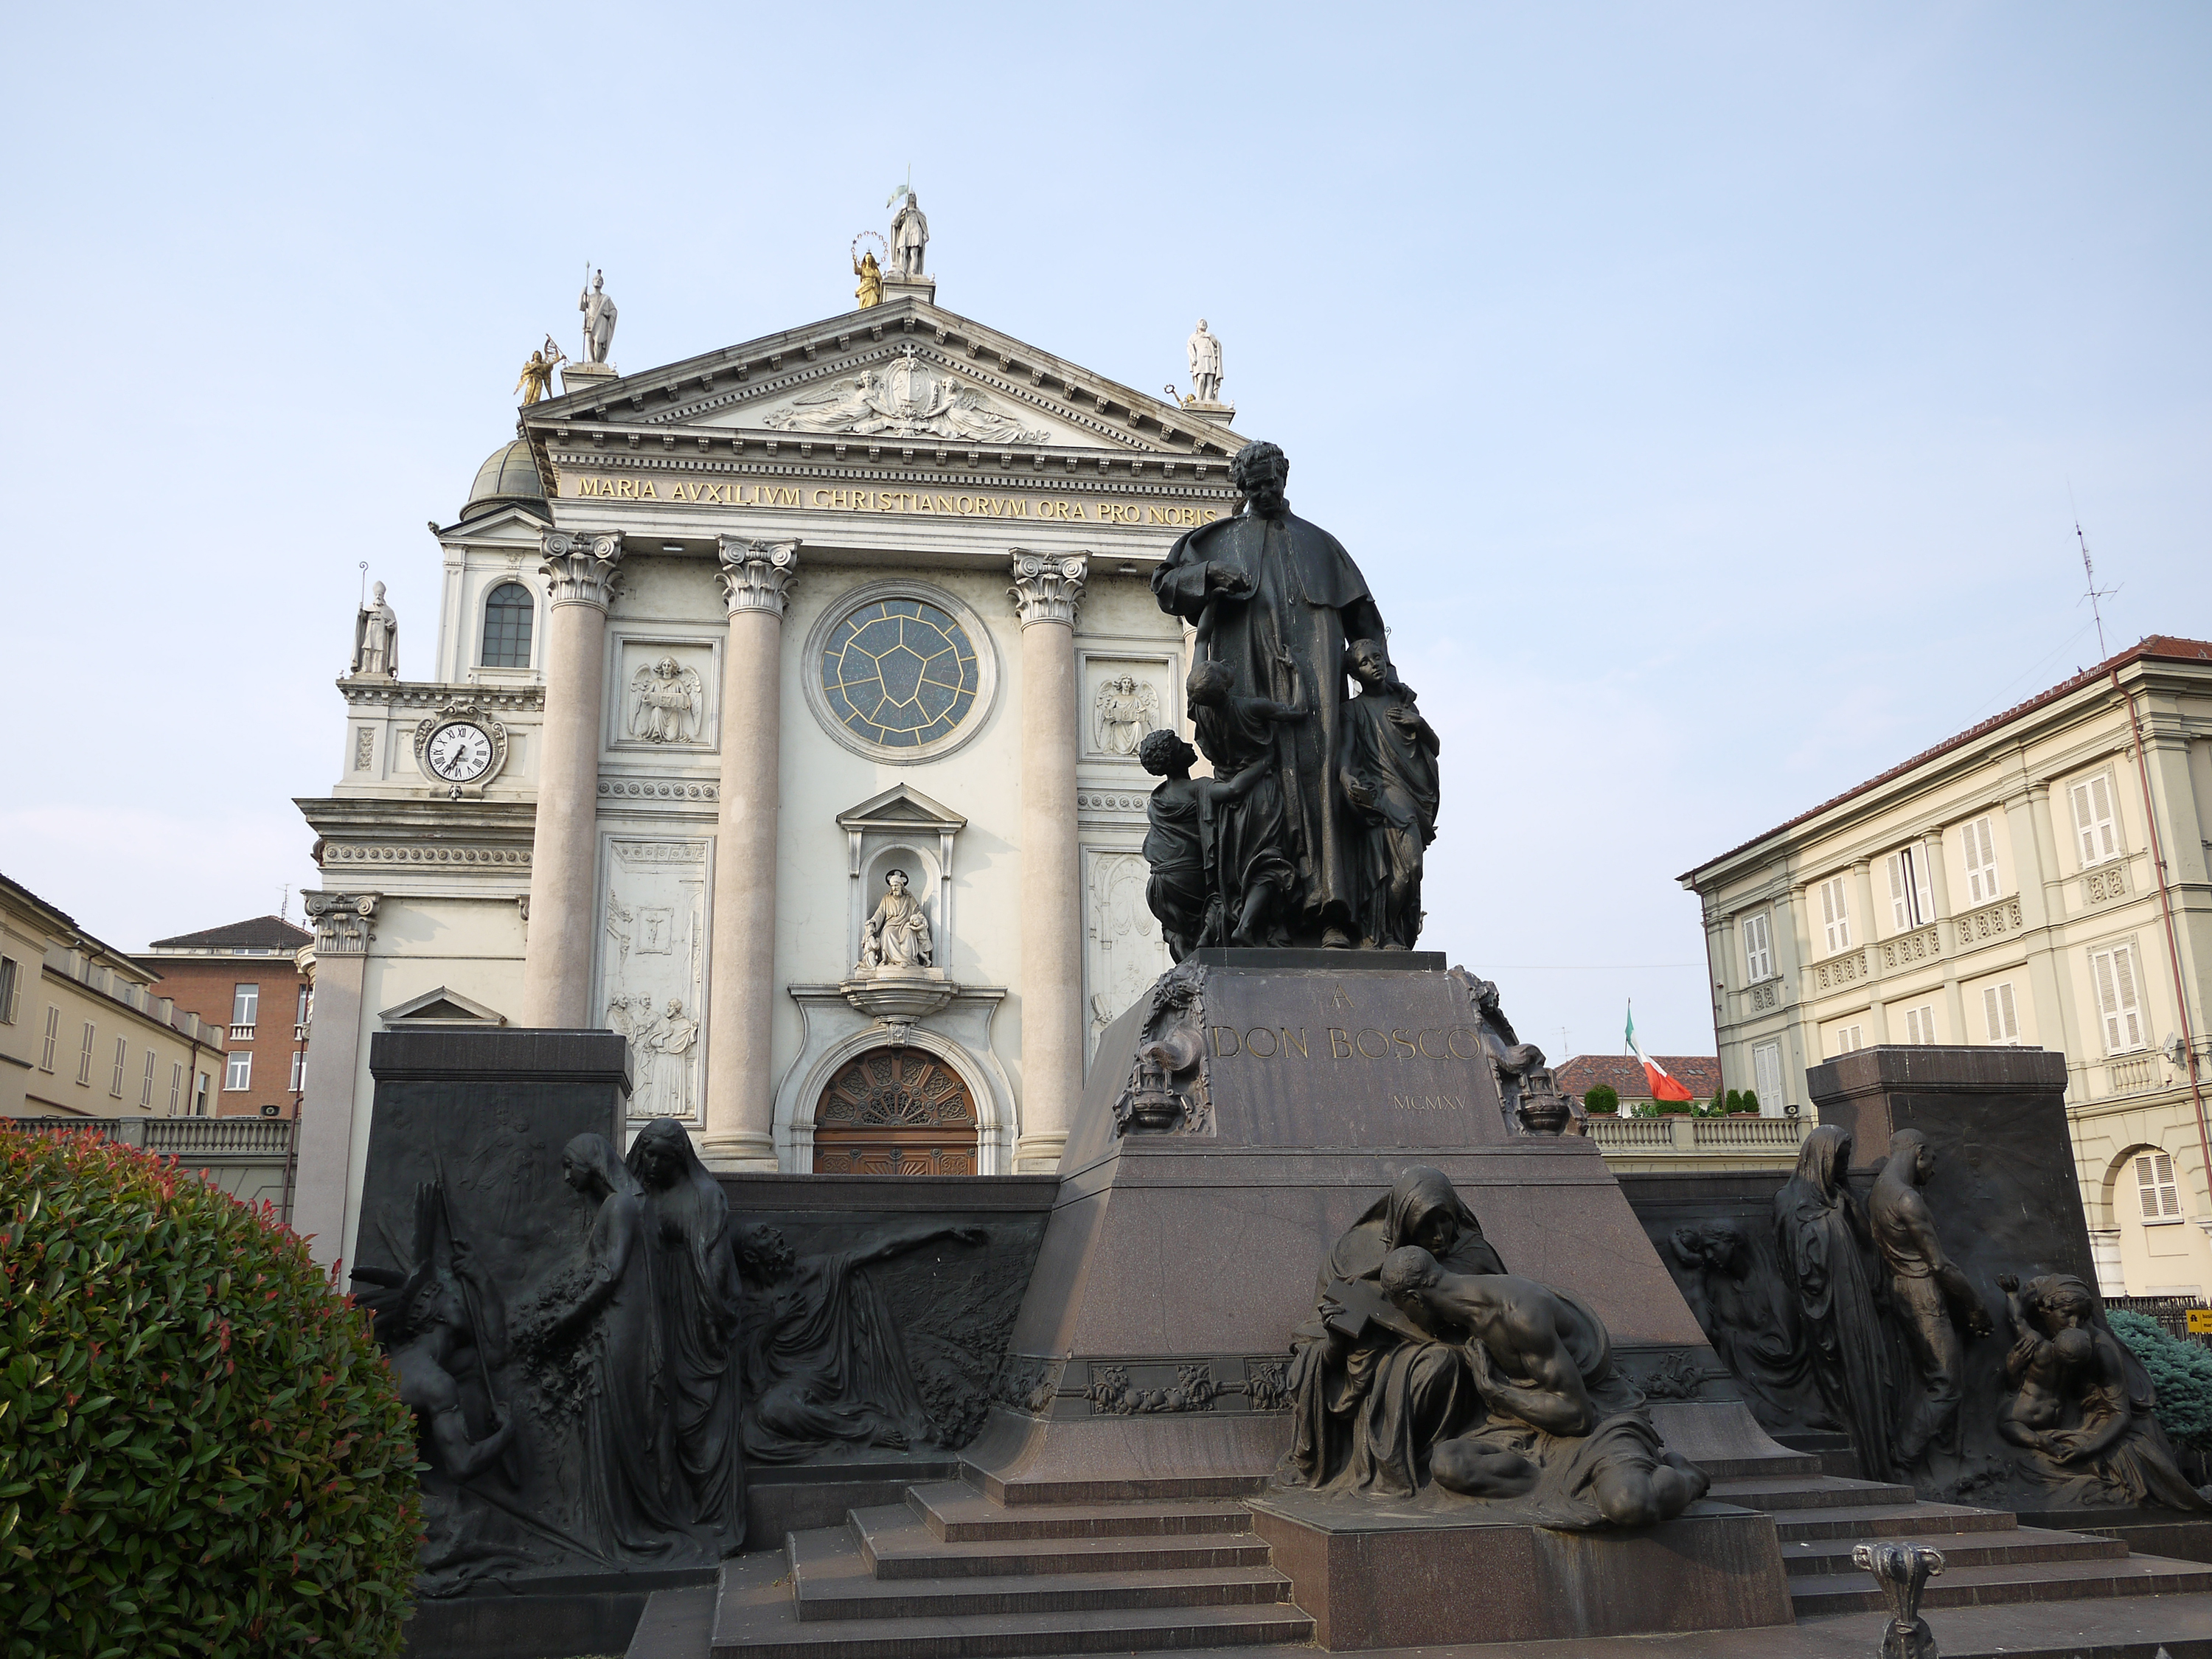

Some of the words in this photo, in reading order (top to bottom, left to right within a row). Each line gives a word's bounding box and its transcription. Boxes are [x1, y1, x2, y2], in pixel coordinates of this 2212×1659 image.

[578, 477, 658, 498] MARIA
[671, 482, 801, 506] AVXILIVM
[813, 488, 1027, 517] CHRISTIANORVM
[1037, 501, 1086, 520] ORA
[1096, 504, 1141, 524] PRO
[1149, 506, 1217, 526] NOBIS
[1330, 984, 1354, 1008] A
[1211, 1026, 1309, 1060] DON
[1327, 1027, 1481, 1060] BOSCO
[1394, 1096, 1466, 1110] MCMXV
